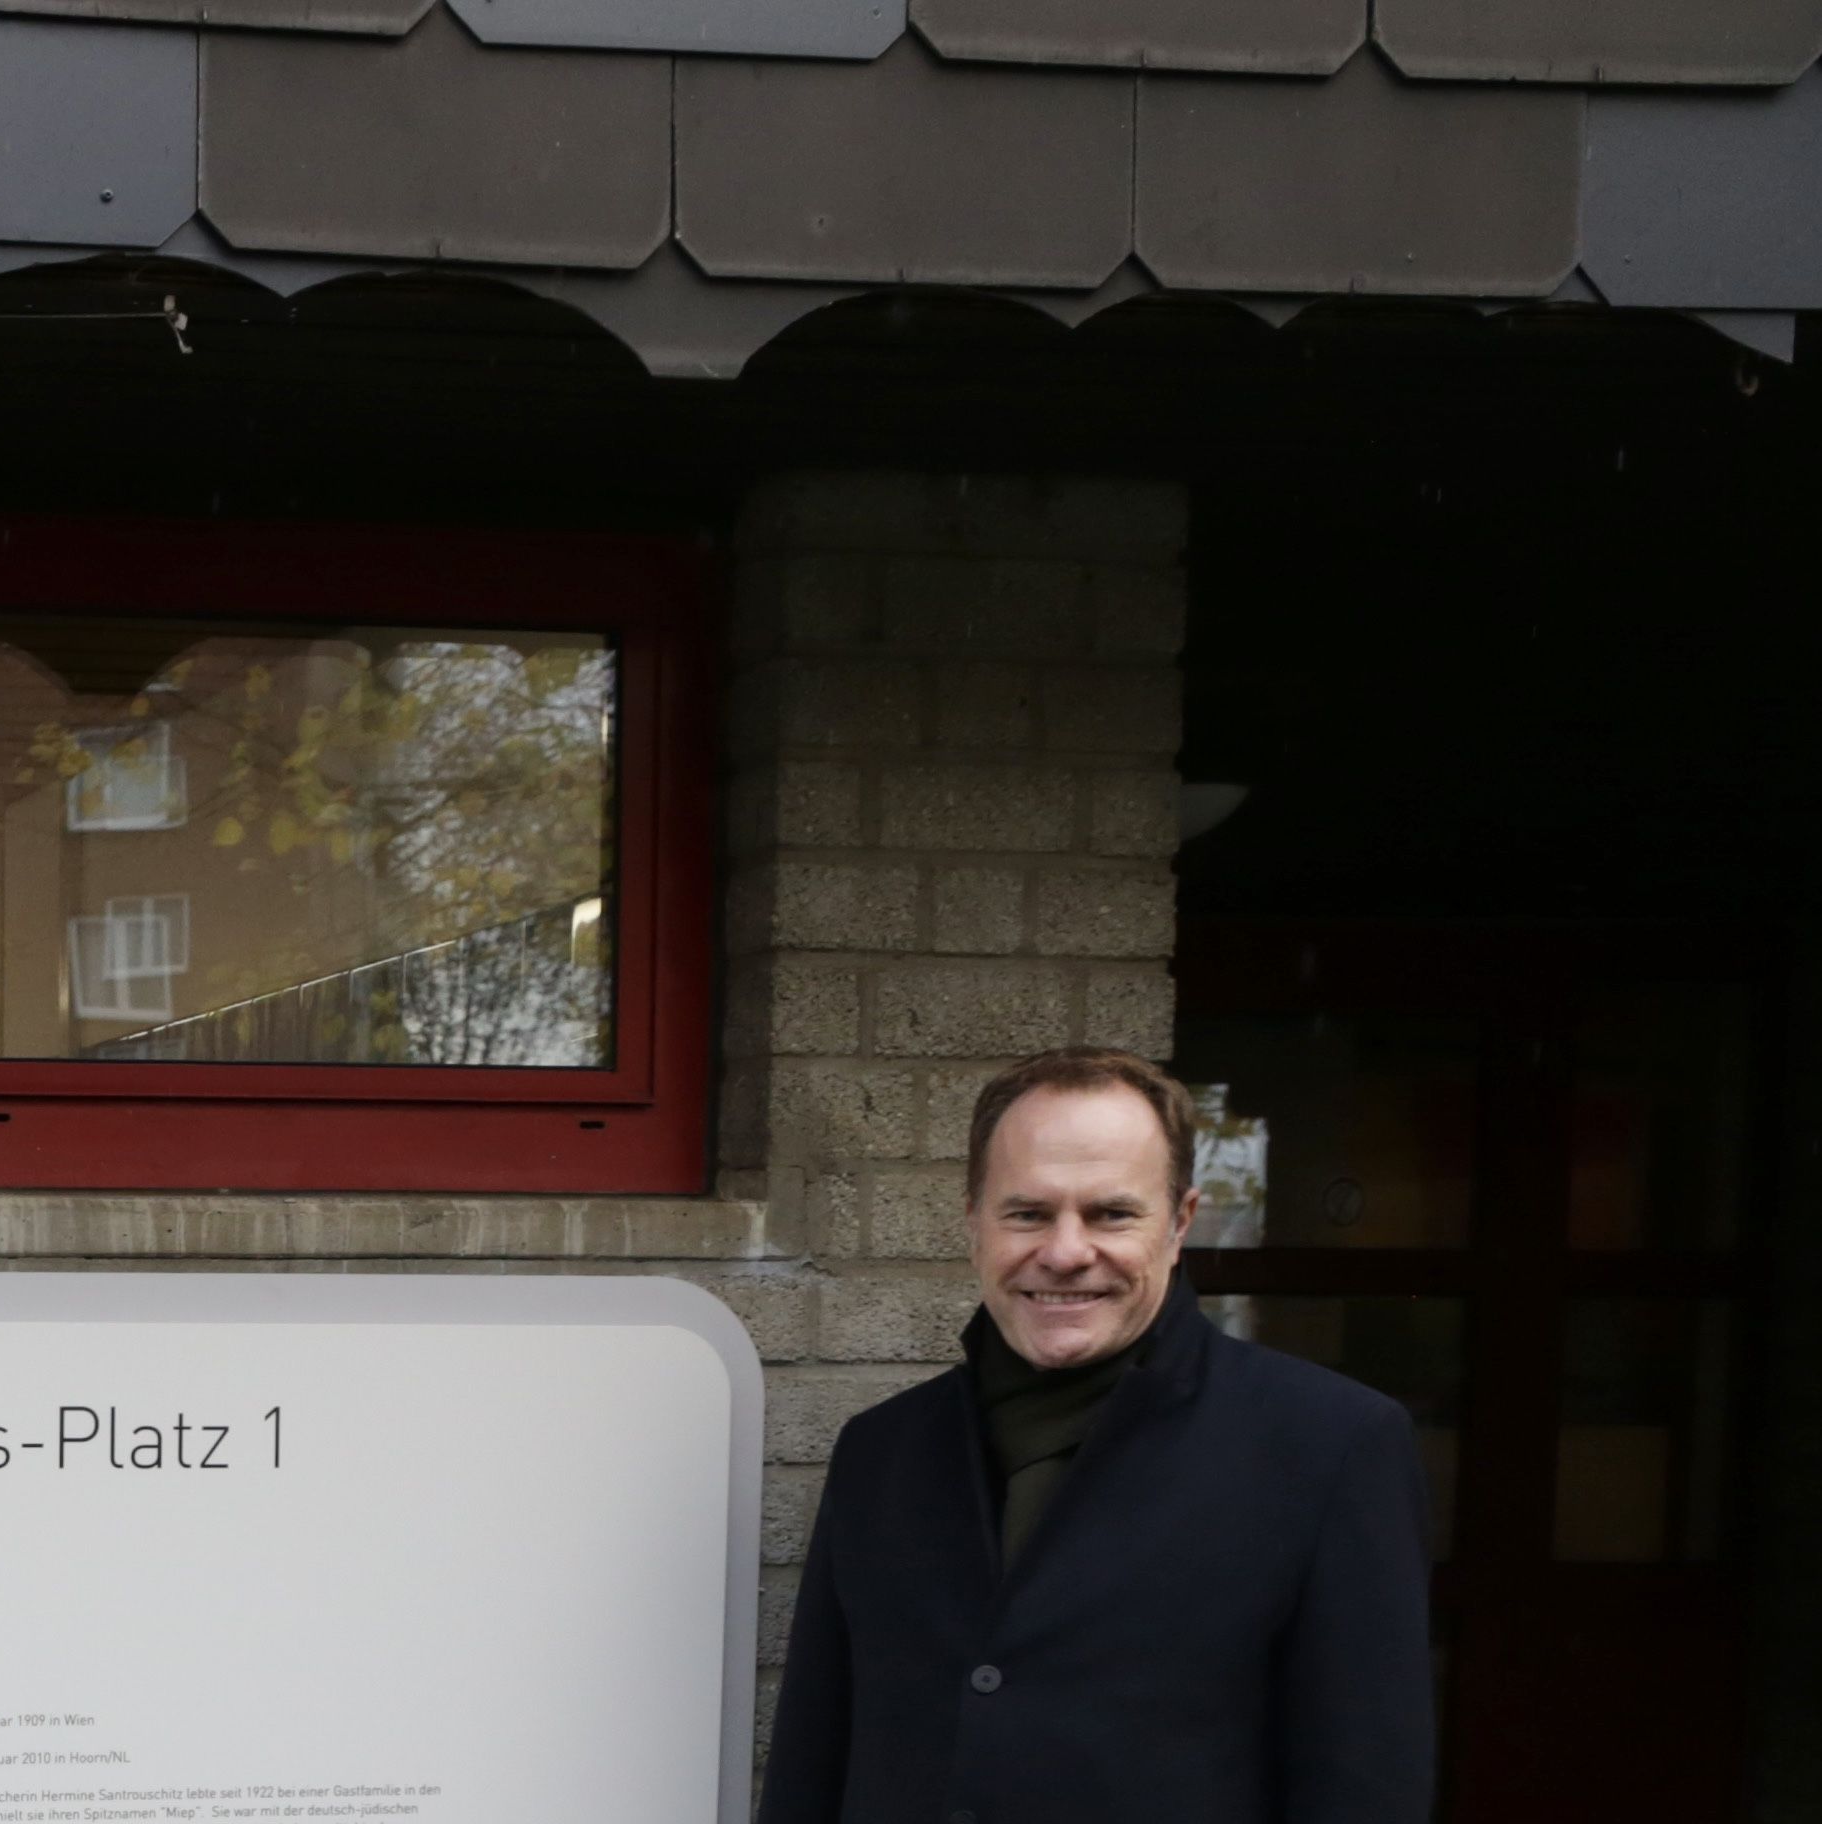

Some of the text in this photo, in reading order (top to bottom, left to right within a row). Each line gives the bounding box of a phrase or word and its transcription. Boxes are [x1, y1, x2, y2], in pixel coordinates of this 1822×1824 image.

[263, 1406, 281, 1469] 1
[16, 1713, 46, 1727] 1909
[48, 1714, 61, 1727] in
[63, 1713, 95, 1726] Wien
[20, 1751, 52, 1765] 2010
[53, 1751, 66, 1764] in
[68, 1750, 131, 1764] Hoorn/NL
[40, 1789, 96, 1802] Hermine
[97, 1788, 184, 1801] Santrouschitz
[185, 1787, 217, 1800] lebte
[218, 1787, 242, 1799] seit
[246, 1784, 275, 1799] 1922
[276, 1785, 296, 1799] bei
[297, 1787, 331, 1798] einer
[332, 1784, 402, 1797] Gastfamilie
[403, 1786, 416, 1795] in
[418, 1783, 442, 1796] den
